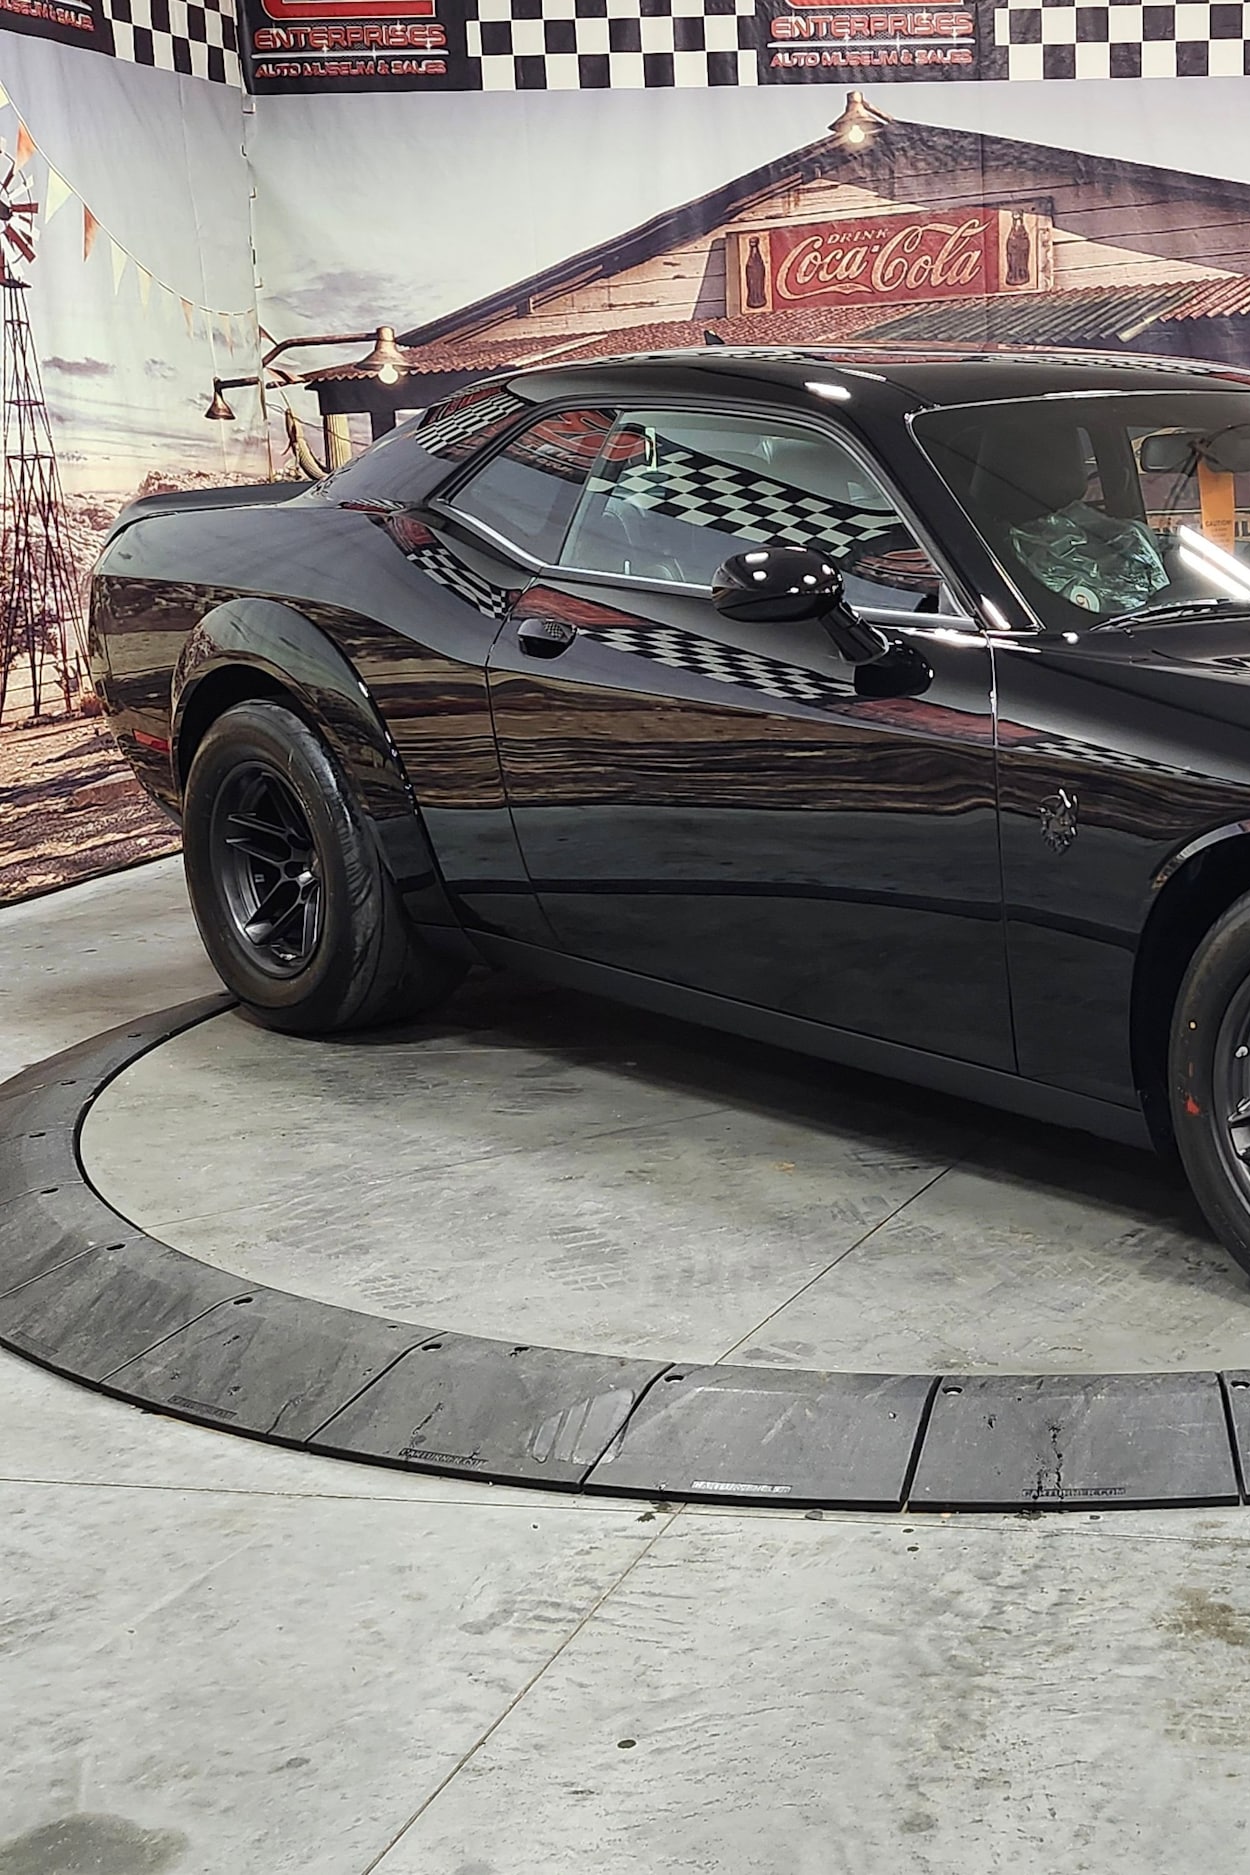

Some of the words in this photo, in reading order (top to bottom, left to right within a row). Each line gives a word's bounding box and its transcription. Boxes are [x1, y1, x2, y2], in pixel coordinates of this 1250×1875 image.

[254, 24, 447, 49] ENTERPRISES
[772, 12, 974, 39] ENTERPRISES
[255, 64, 300, 78] AUTO
[302, 62, 375, 77] MUSEUM
[376, 60, 389, 75] &
[391, 60, 447, 74] SALES
[770, 52, 820, 68] AUTO
[821, 50, 898, 66] MUSEUM
[900, 49, 913, 65] &
[914, 48, 974, 64] SALES
[827, 228, 890, 244] DRINK
[776, 218, 993, 300] Coca-Cola
